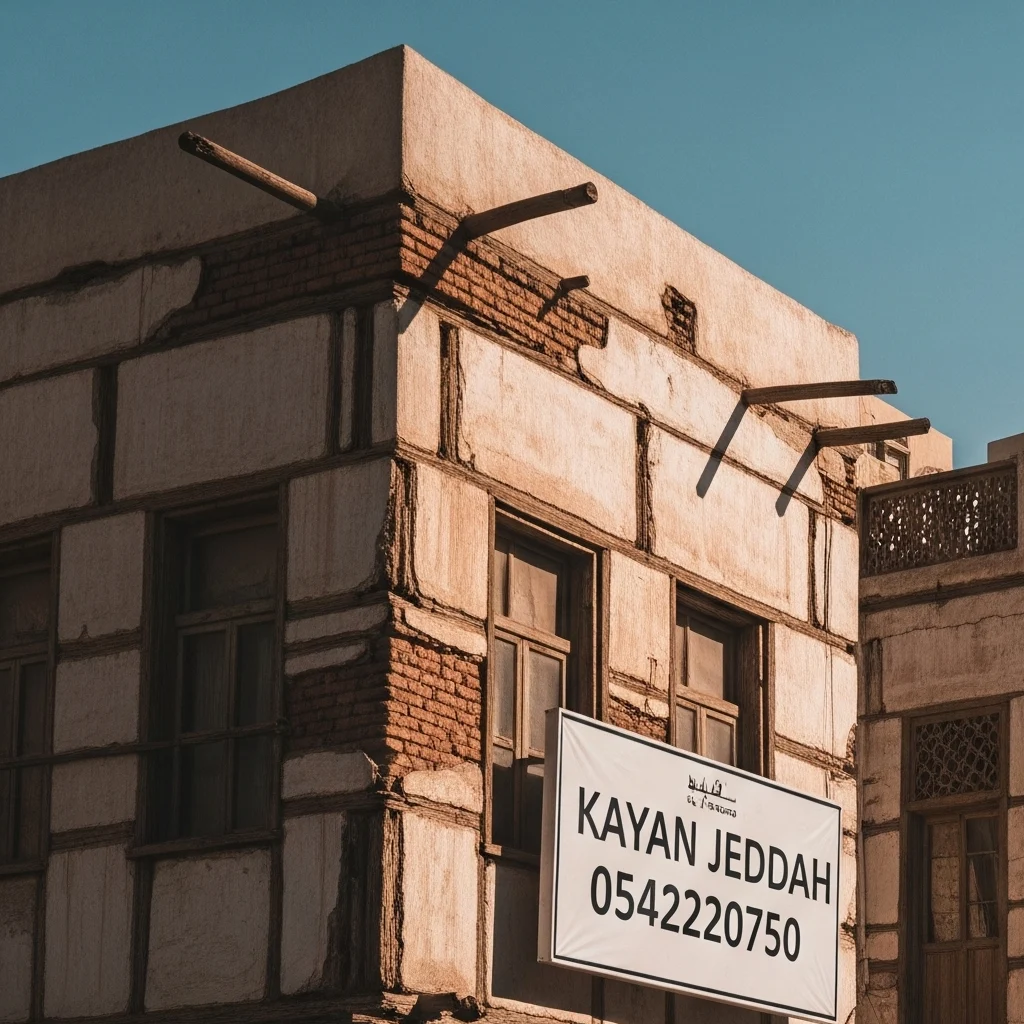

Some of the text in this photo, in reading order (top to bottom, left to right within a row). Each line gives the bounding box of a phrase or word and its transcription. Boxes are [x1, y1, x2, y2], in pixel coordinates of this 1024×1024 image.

[578, 786, 831, 904] KAYAN JEDDAH
[590, 865, 801, 962] 0542220750
